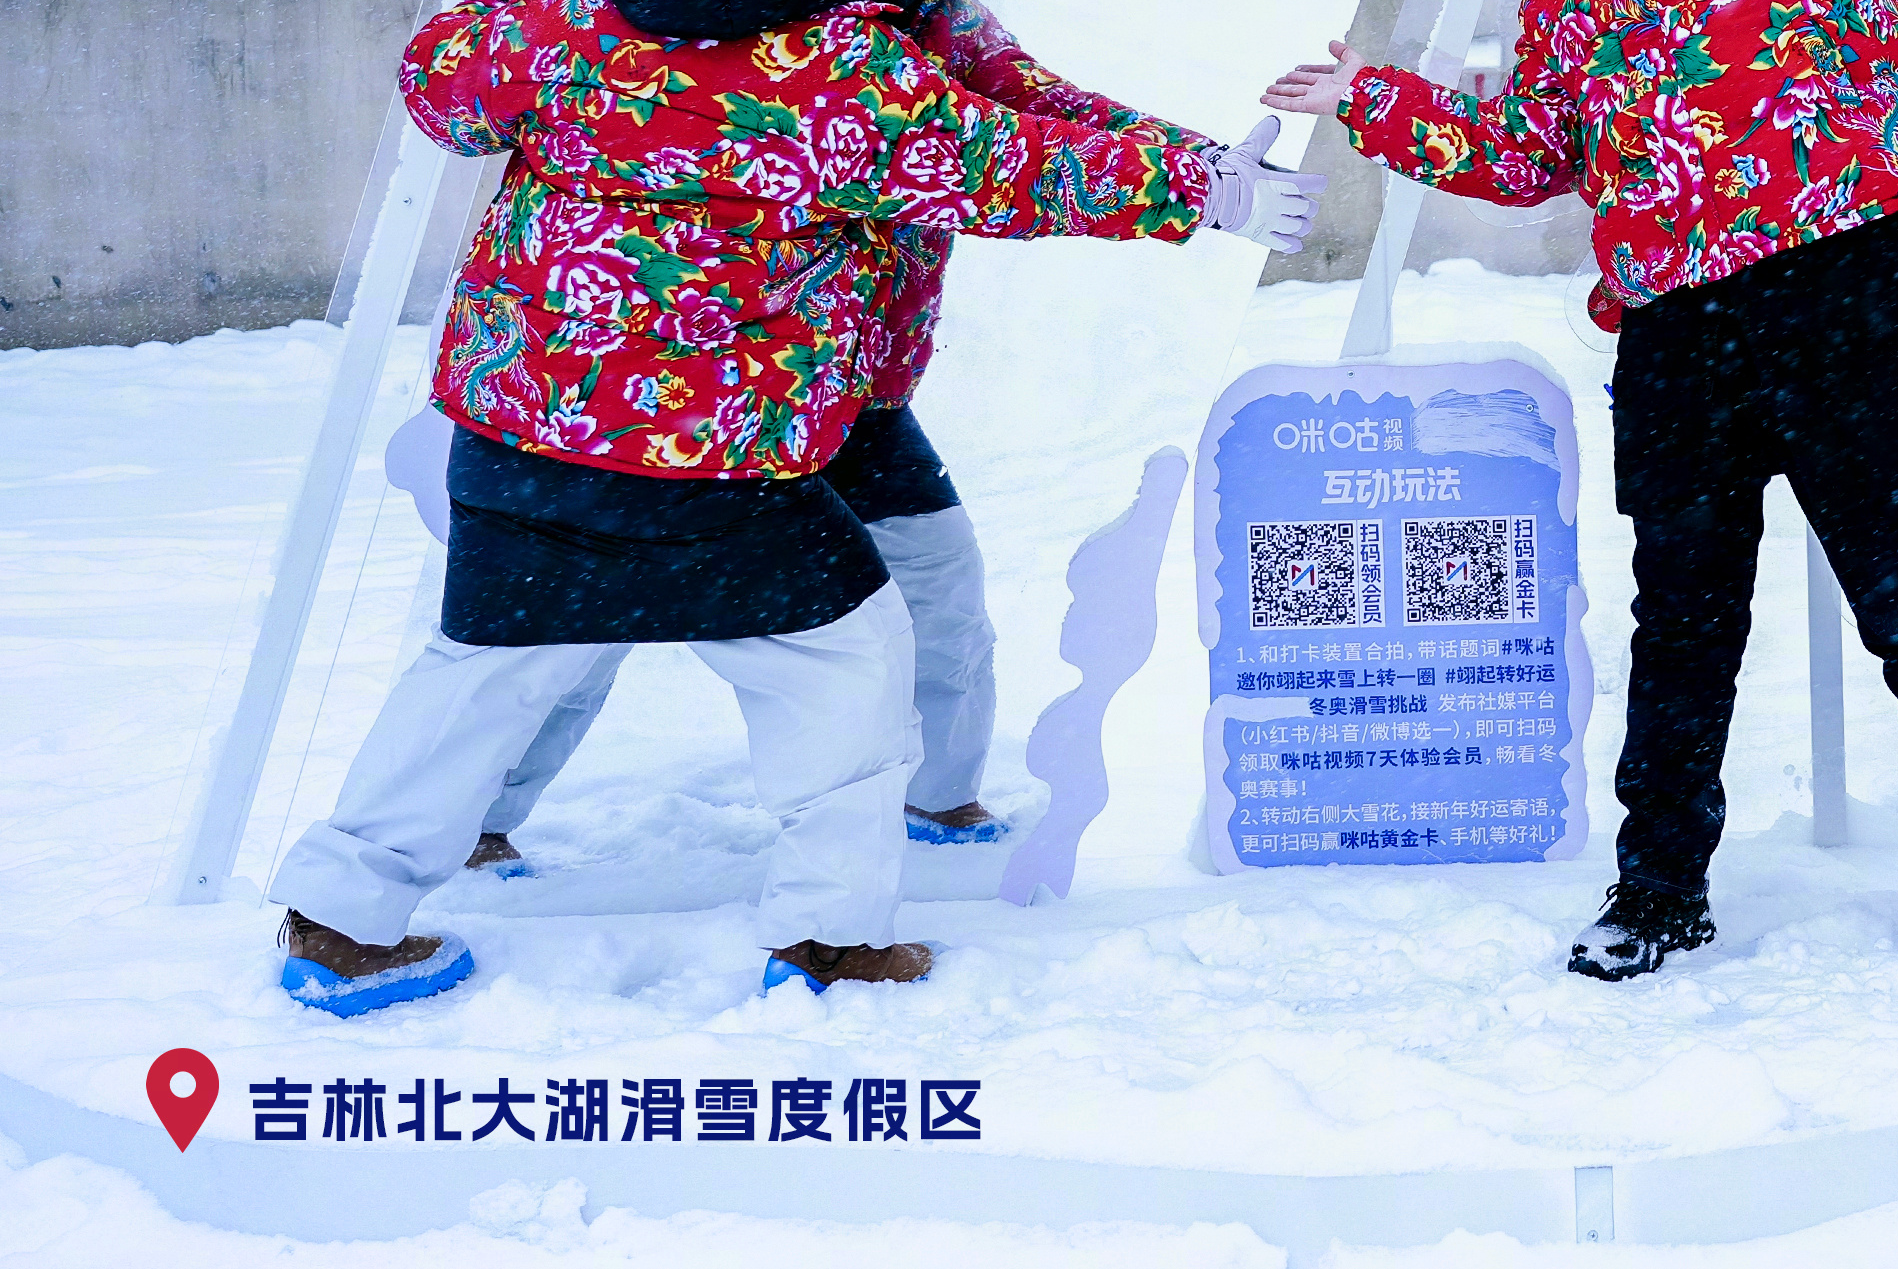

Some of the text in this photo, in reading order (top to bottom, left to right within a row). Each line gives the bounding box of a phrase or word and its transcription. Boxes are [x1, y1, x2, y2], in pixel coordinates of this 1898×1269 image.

[1321, 467, 1462, 509] 互动玩法
[1360, 523, 1382, 624] 扫码领会员
[1513, 518, 1535, 619] 扫码赢金卡
[1236, 663, 1556, 692] 邀你翊起来雪上转一圈 #翊起转好运
[1309, 690, 1556, 717] 冬奥滑雪挑战 发布社媒平台
